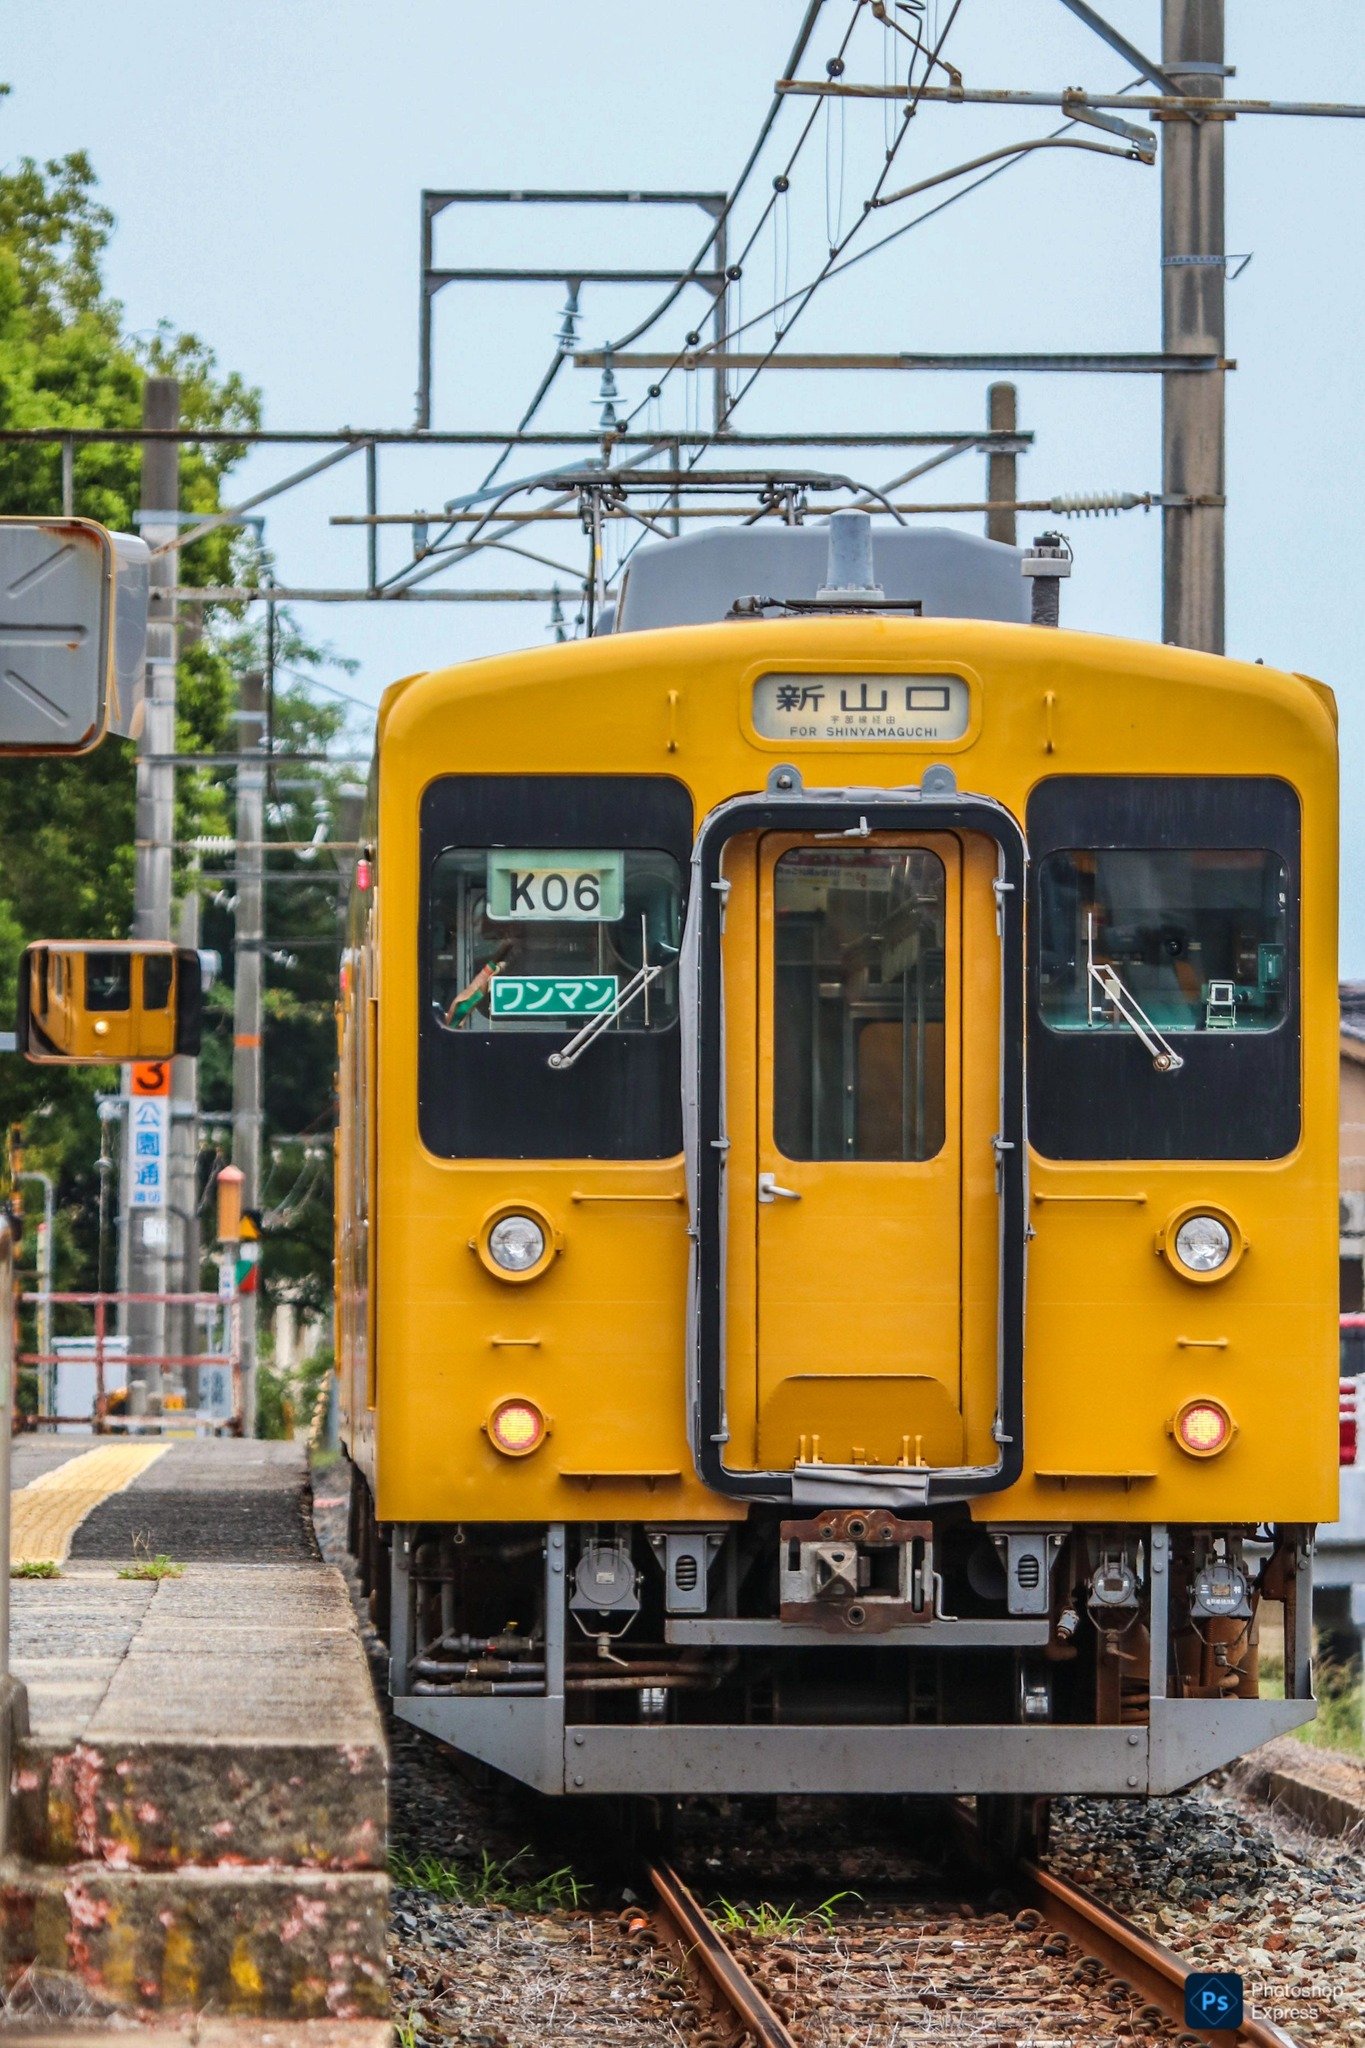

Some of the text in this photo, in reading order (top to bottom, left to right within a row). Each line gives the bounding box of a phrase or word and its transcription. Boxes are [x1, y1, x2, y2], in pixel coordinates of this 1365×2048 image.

[776, 683, 950, 712] 新山口
[789, 726, 938, 738] FOR SHINYAMAGUCHI
[509, 872, 600, 912] K06
[496, 982, 613, 1010] ワンマン
[137, 1062, 164, 1090] 3
